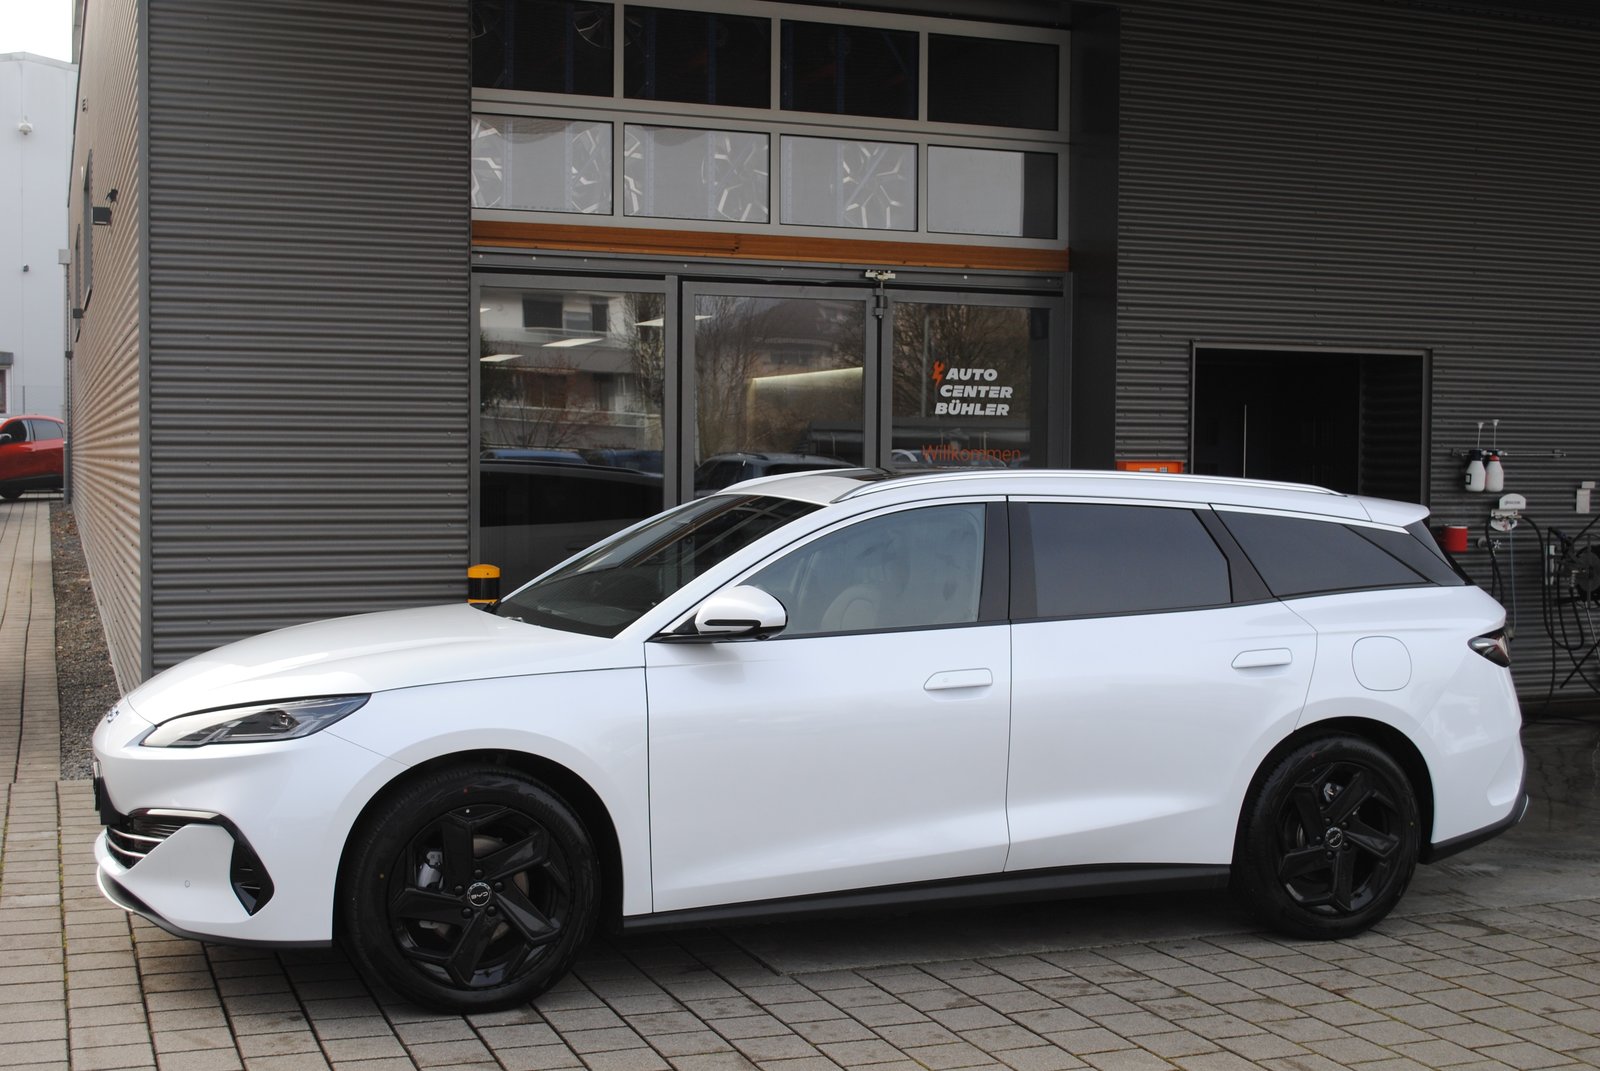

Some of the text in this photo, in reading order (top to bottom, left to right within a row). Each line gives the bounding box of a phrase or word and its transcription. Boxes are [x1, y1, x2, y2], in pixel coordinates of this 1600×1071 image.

[945, 368, 998, 382] AUTO
[940, 385, 1014, 398] CENTER
[935, 400, 1010, 416] BÜHLER
[922, 445, 1021, 461] Willkommen
